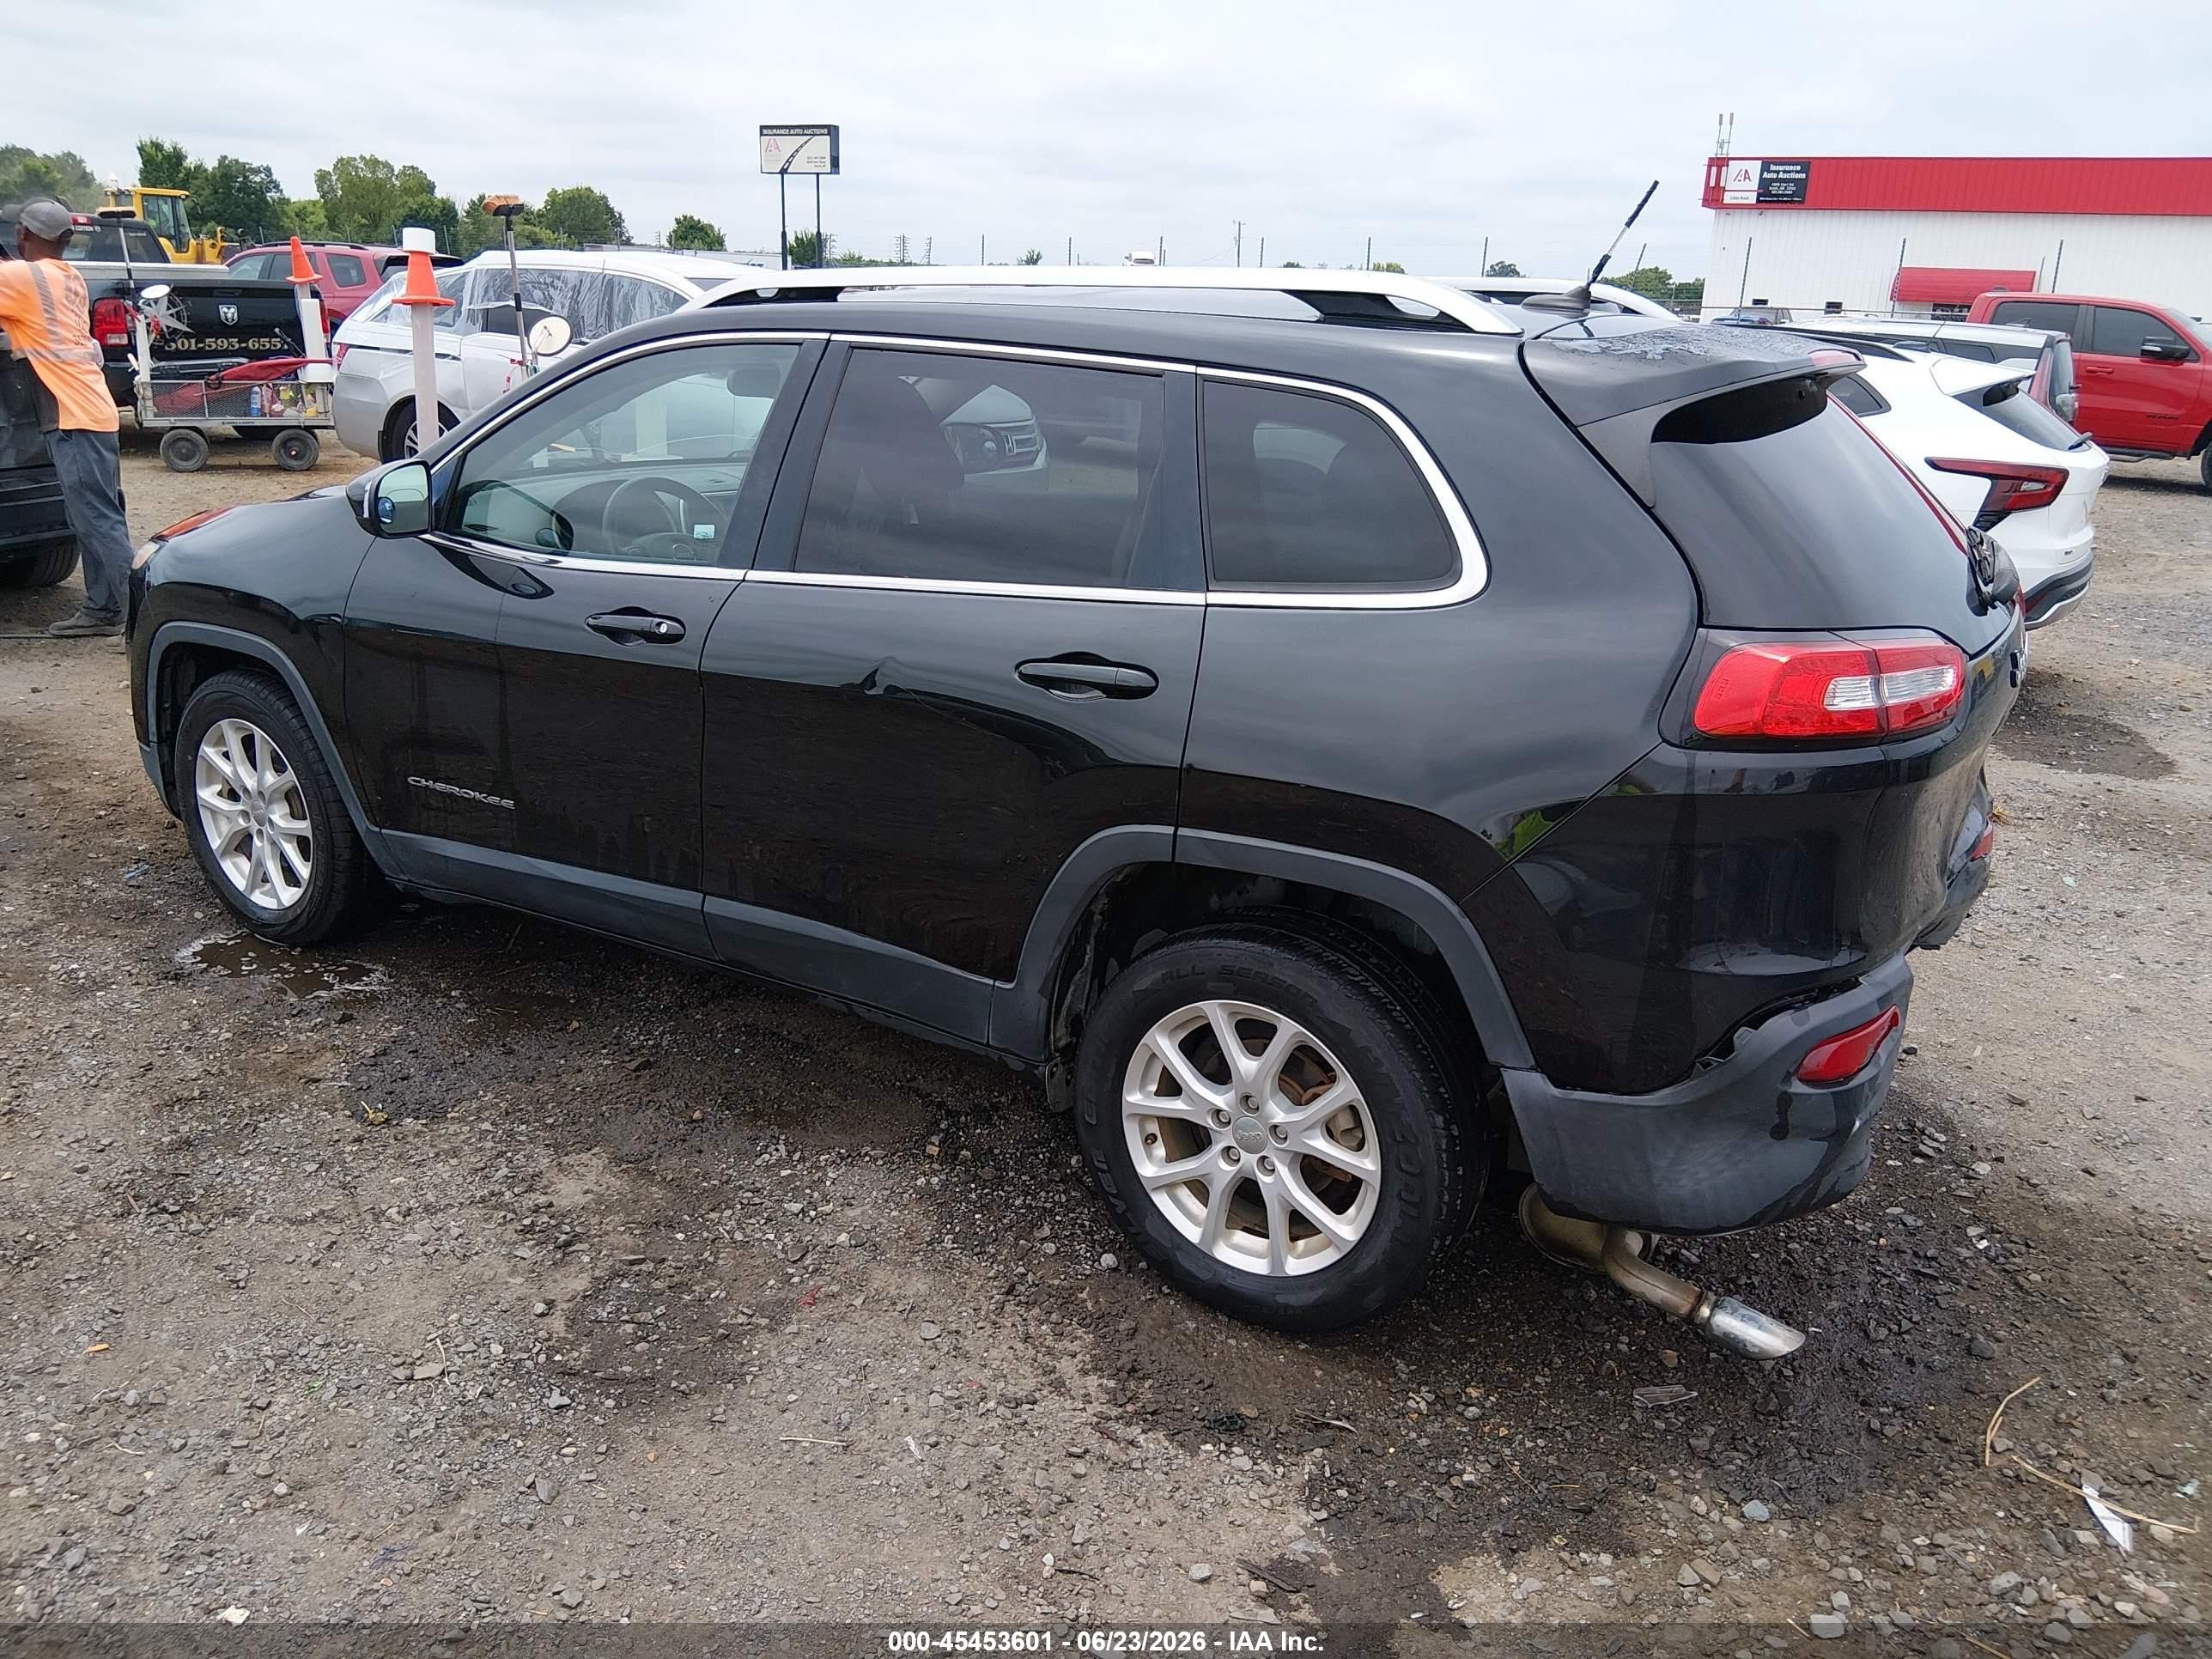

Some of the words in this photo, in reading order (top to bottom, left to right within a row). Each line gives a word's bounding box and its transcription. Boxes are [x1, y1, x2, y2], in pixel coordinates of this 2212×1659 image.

[1778, 171, 1807, 179] Auctions
[407, 775, 517, 810] CHEROKEE
[1236, 1129, 1264, 1142] Jeep
